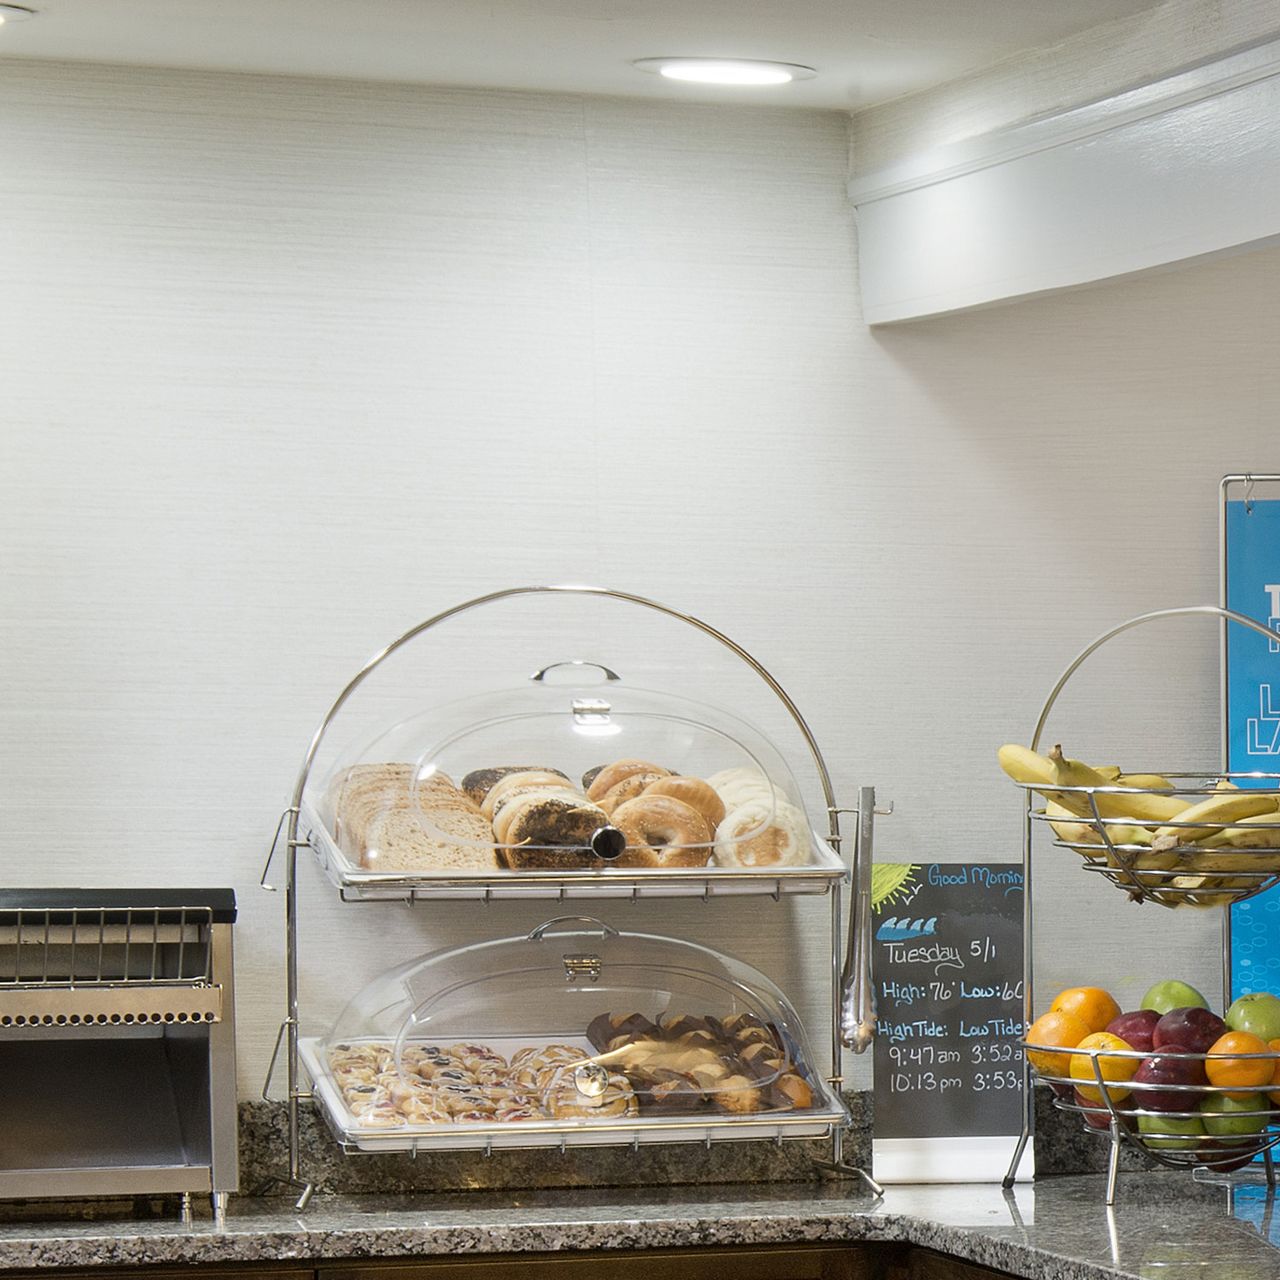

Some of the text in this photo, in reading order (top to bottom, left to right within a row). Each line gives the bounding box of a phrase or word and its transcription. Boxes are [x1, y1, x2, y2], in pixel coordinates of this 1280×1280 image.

[928, 864, 1023, 896] Good Mornin
[883, 936, 996, 976] Tuesday 5/1
[883, 981, 925, 1007] High:
[960, 981, 1000, 999] Low:
[877, 1021, 913, 1043] High
[960, 1021, 989, 1037] Low
